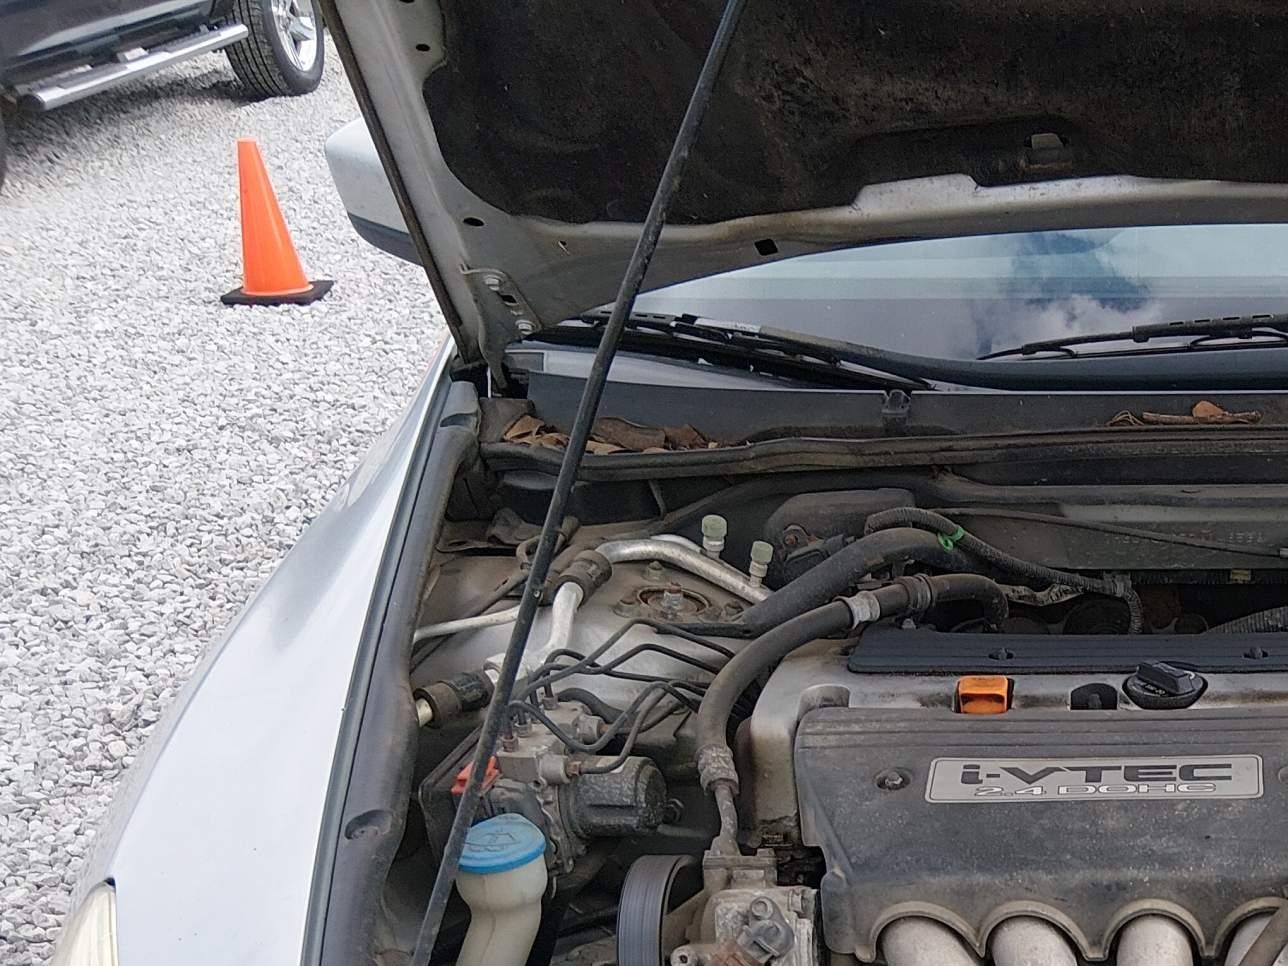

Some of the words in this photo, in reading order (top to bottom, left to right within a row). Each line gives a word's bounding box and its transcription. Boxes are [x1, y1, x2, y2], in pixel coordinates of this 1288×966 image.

[961, 763, 1233, 785] i-VTEC
[974, 785, 1046, 797] 2.4
[1057, 782, 1217, 796] DOHC
